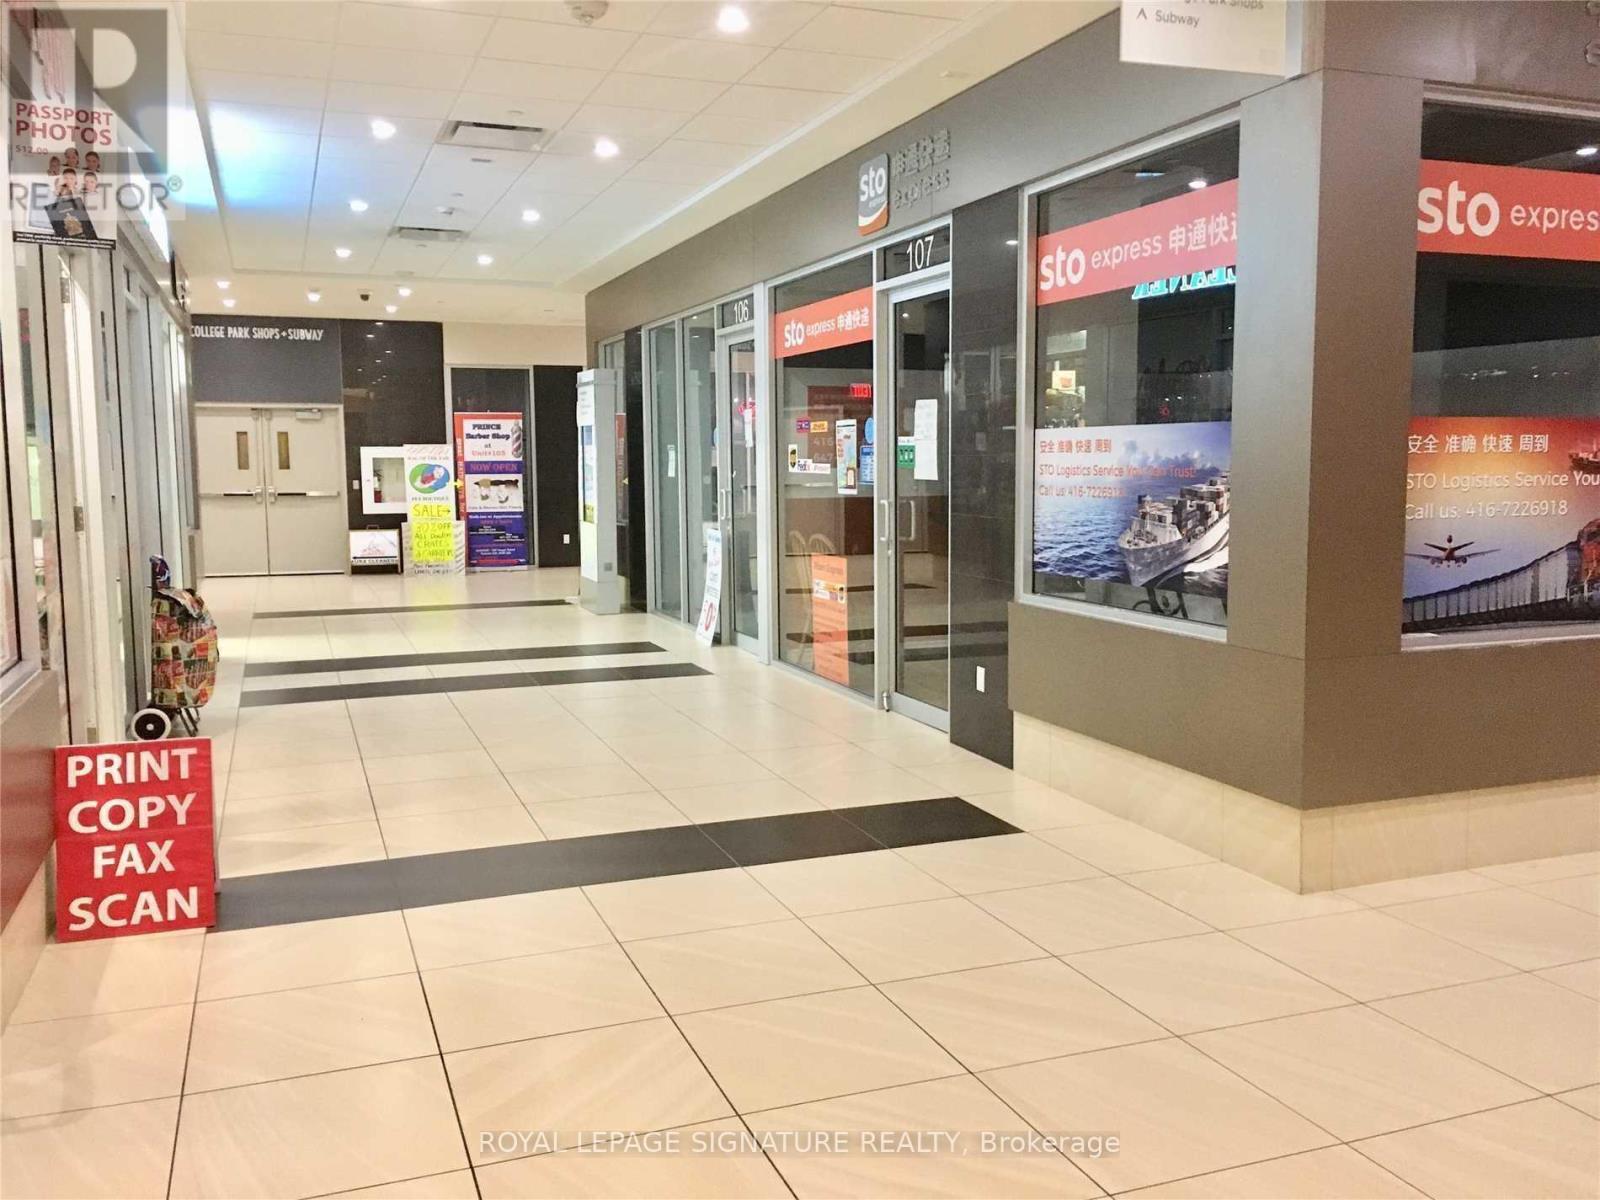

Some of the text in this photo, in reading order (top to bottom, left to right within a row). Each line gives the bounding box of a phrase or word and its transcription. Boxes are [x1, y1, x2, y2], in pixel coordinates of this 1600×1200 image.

[1155, 10, 1200, 27] Subway
[16, 102, 113, 126] PASSPORT
[16, 120, 112, 146] PHOTOS
[860, 167, 886, 202] sto
[1417, 180, 1500, 237] sto
[906, 235, 934, 272] 107
[1040, 244, 1085, 291] sto
[1091, 235, 1163, 270] express
[734, 299, 749, 323] 106
[228, 326, 250, 338] PARK
[252, 327, 280, 340] SHOPS
[784, 319, 805, 349] sto
[806, 320, 836, 337] express
[491, 433, 511, 441] Shop
[1407, 434, 1549, 454] 安全 准确 快速 周到
[471, 463, 518, 471] NOW OPEN
[1039, 464, 1055, 476] STO
[1056, 464, 1091, 478] Logistics
[1093, 464, 1124, 477] Service
[1039, 485, 1054, 497] Call
[1406, 472, 1436, 490] STO
[1442, 472, 1510, 492] Logistics
[1515, 471, 1568, 487] Service
[413, 504, 442, 517] SALE
[1405, 500, 1569, 520] Call us: 416-7226918
[67, 747, 198, 788] PRINT
[67, 792, 197, 834] COPY
[93, 839, 176, 879] FAX
[68, 886, 198, 931] SCAN
